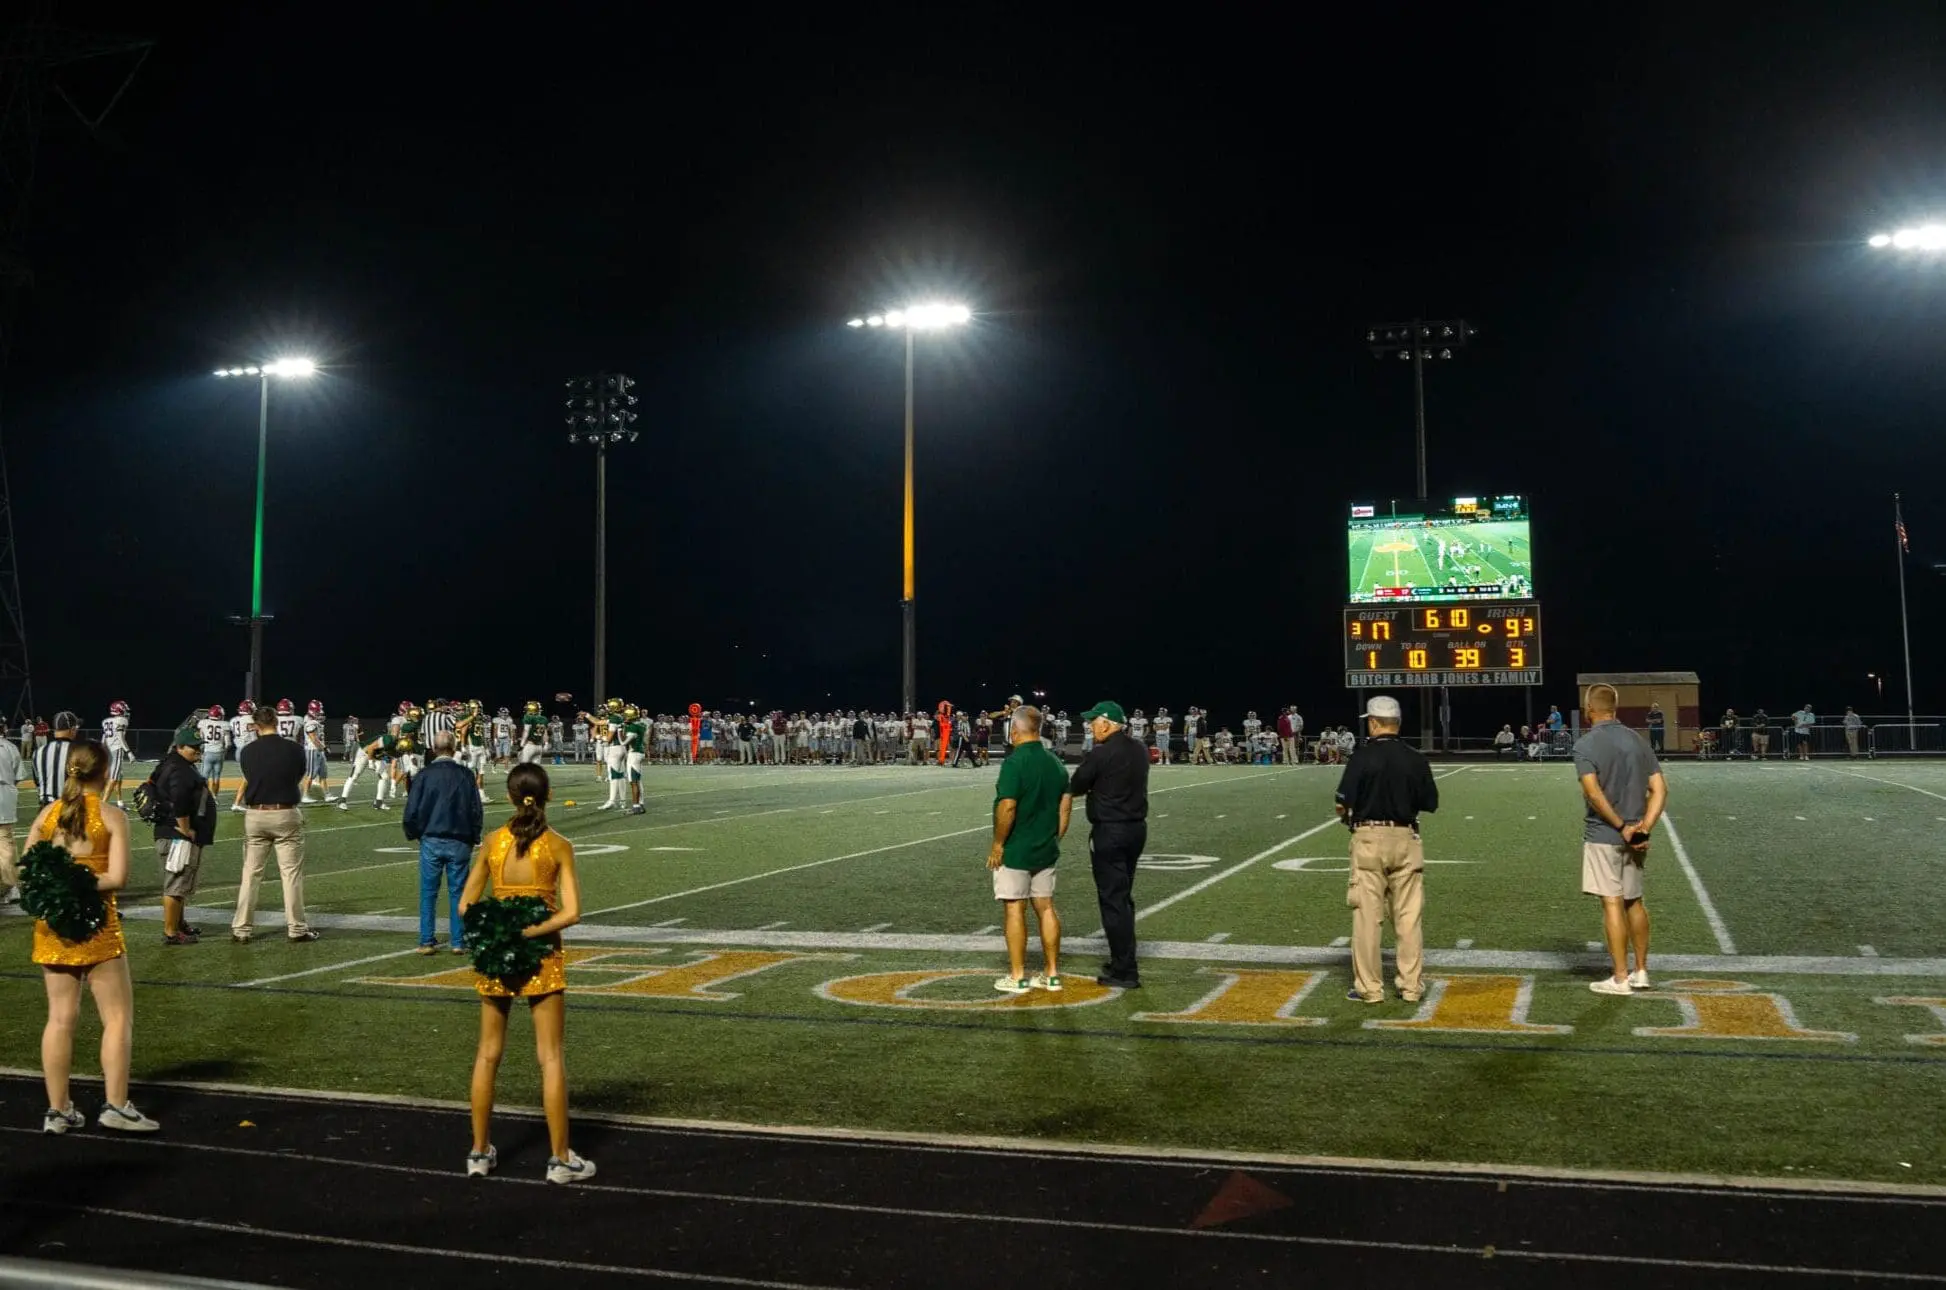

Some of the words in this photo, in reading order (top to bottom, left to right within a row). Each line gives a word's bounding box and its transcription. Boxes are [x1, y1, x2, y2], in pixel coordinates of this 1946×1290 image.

[1359, 611, 1398, 620] GUEST
[1487, 608, 1526, 618] IRISH
[1352, 623, 1361, 635] 3
[1506, 619, 1519, 637] 9
[1524, 619, 1533, 631] 3
[1356, 643, 1382, 651] DOWN
[1369, 651, 1377, 669] 1
[1409, 650, 1426, 669] 10
[1455, 648, 1479, 668] 39
[1510, 648, 1523, 667] 3
[1351, 673, 1391, 685] BUTCH
[1394, 674, 1403, 684] &
[1407, 673, 1438, 685] BARB
[1441, 672, 1479, 685] JONES
[1482, 673, 1491, 684] &
[1495, 671, 1537, 683] FAMILY
[207, 725, 221, 740] 36
[280, 721, 295, 737] 57
